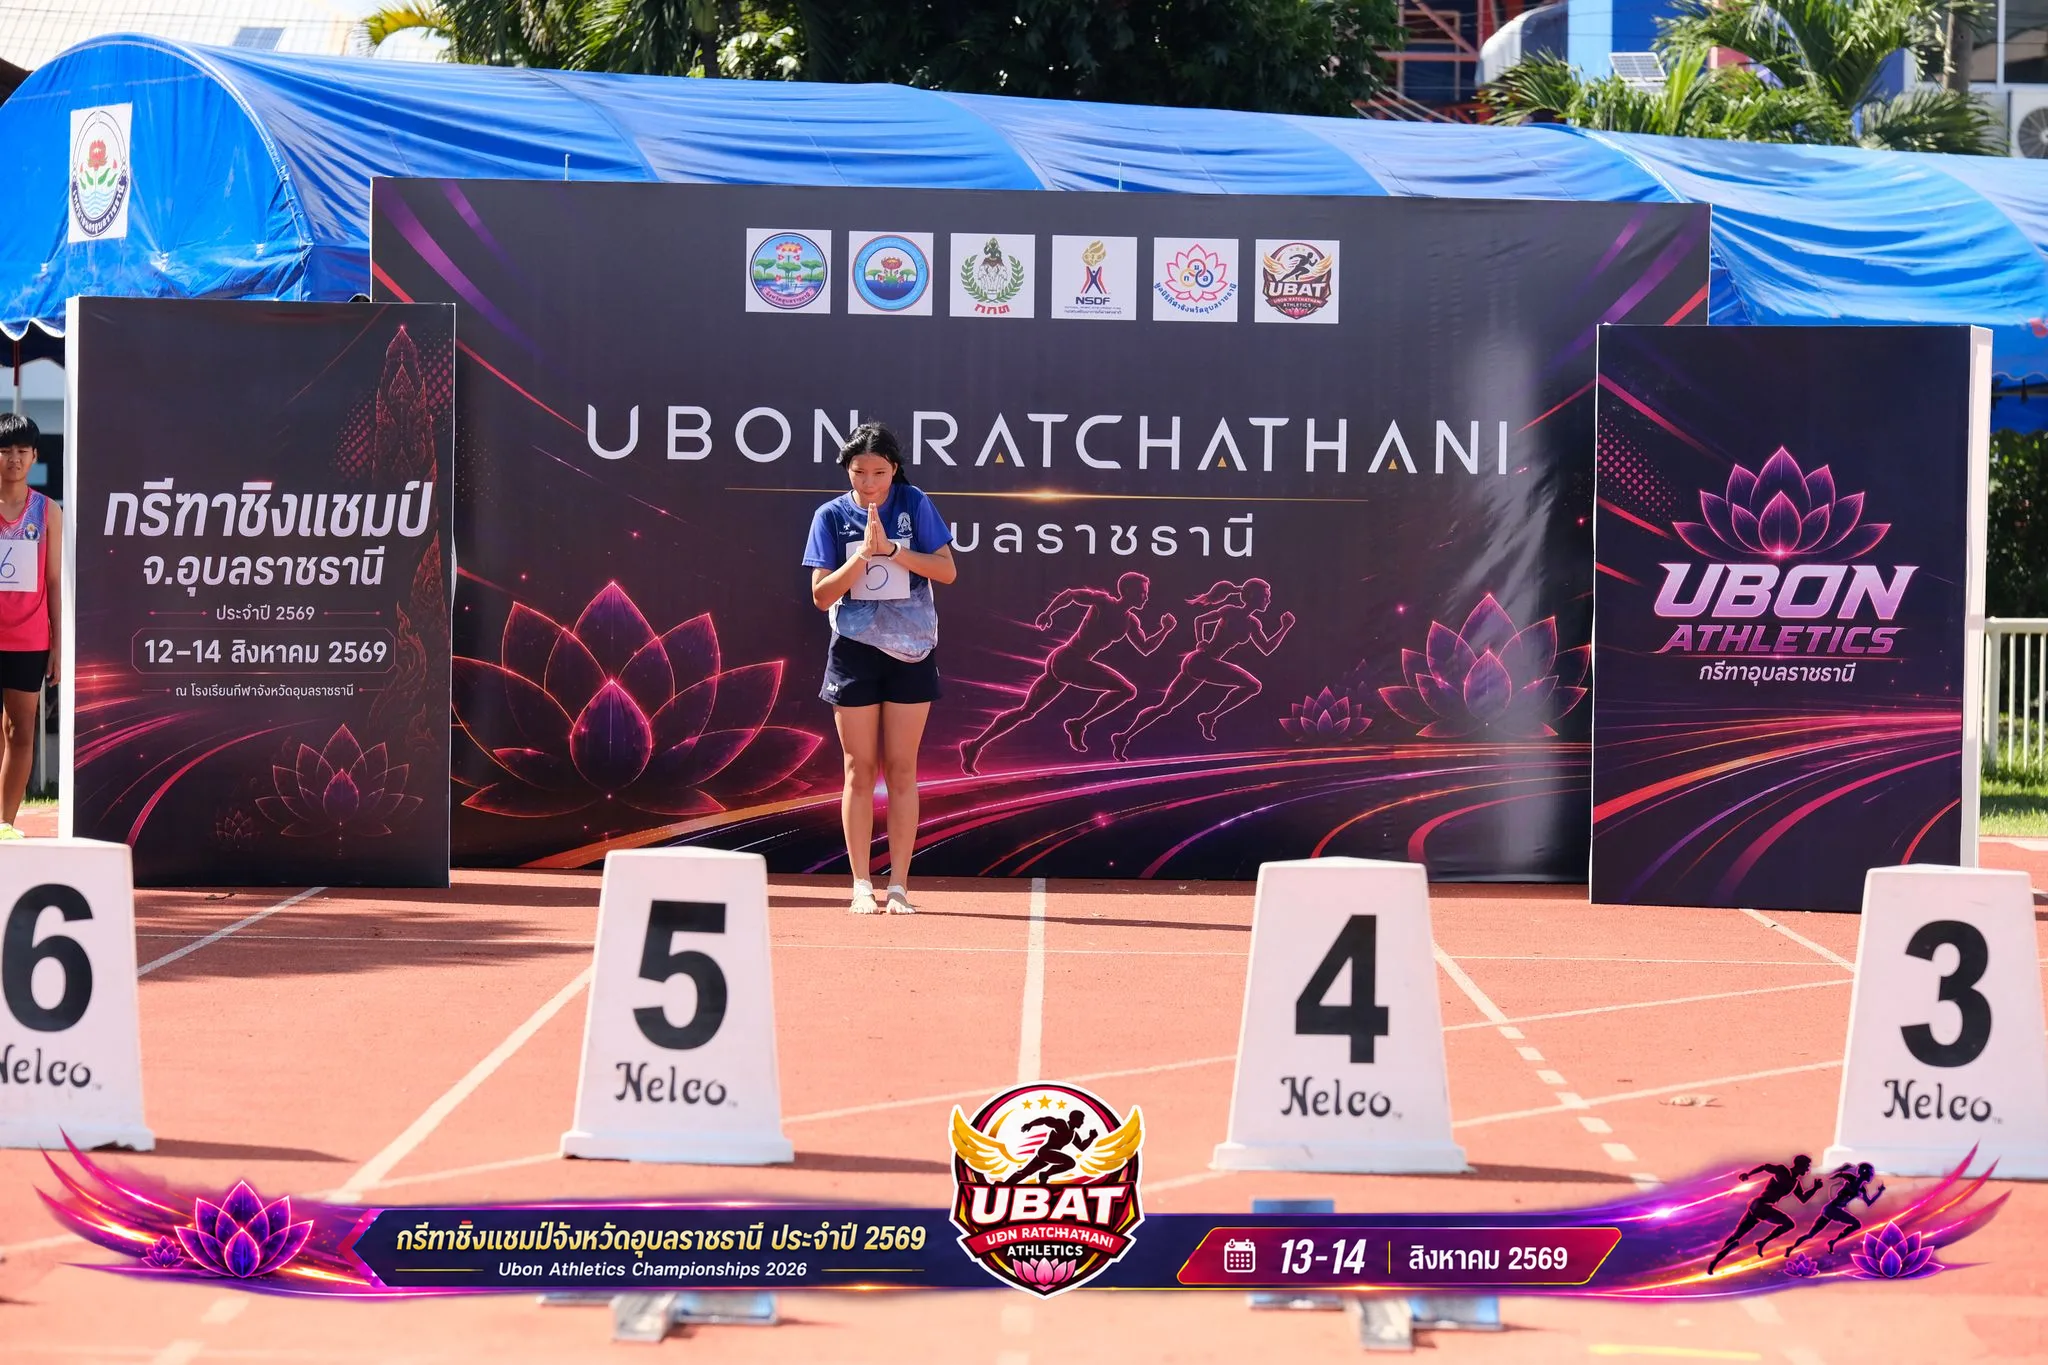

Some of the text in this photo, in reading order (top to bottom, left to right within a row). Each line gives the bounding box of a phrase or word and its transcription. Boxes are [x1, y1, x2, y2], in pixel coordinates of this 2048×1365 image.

[1075, 296, 1111, 305] NSDF
[1268, 282, 1327, 297] UBAT
[587, 404, 1508, 475] UBON RATCHATHANI
[103, 477, 434, 538] กรีฑาชิงแชมป์
[951, 512, 1254, 558] บลราชธานี
[0, 546, 16, 579] 6
[143, 545, 386, 597] จ.อุบลราชธานี
[865, 554, 889, 591] 5
[216, 603, 315, 621] ประจำปี 2569
[1653, 562, 1920, 620] UBON
[144, 639, 387, 664] 12-14 สิงหาคม 2569
[1651, 624, 1906, 655] ATHLETICS
[175, 682, 354, 700] ณ โรงเรียนกีฬาจังหวัดอุบลราชธานี
[1699, 660, 1857, 687] กรีฑาอุบลราชธานี
[0, 883, 93, 1032] 6
[633, 900, 728, 1050] 5
[1295, 914, 1389, 1064] 4
[1900, 920, 1992, 1068] 3
[615, 1062, 727, 1106] Nelco
[1280, 1076, 1391, 1118] Nelco
[1883, 1079, 1992, 1123] Nelco
